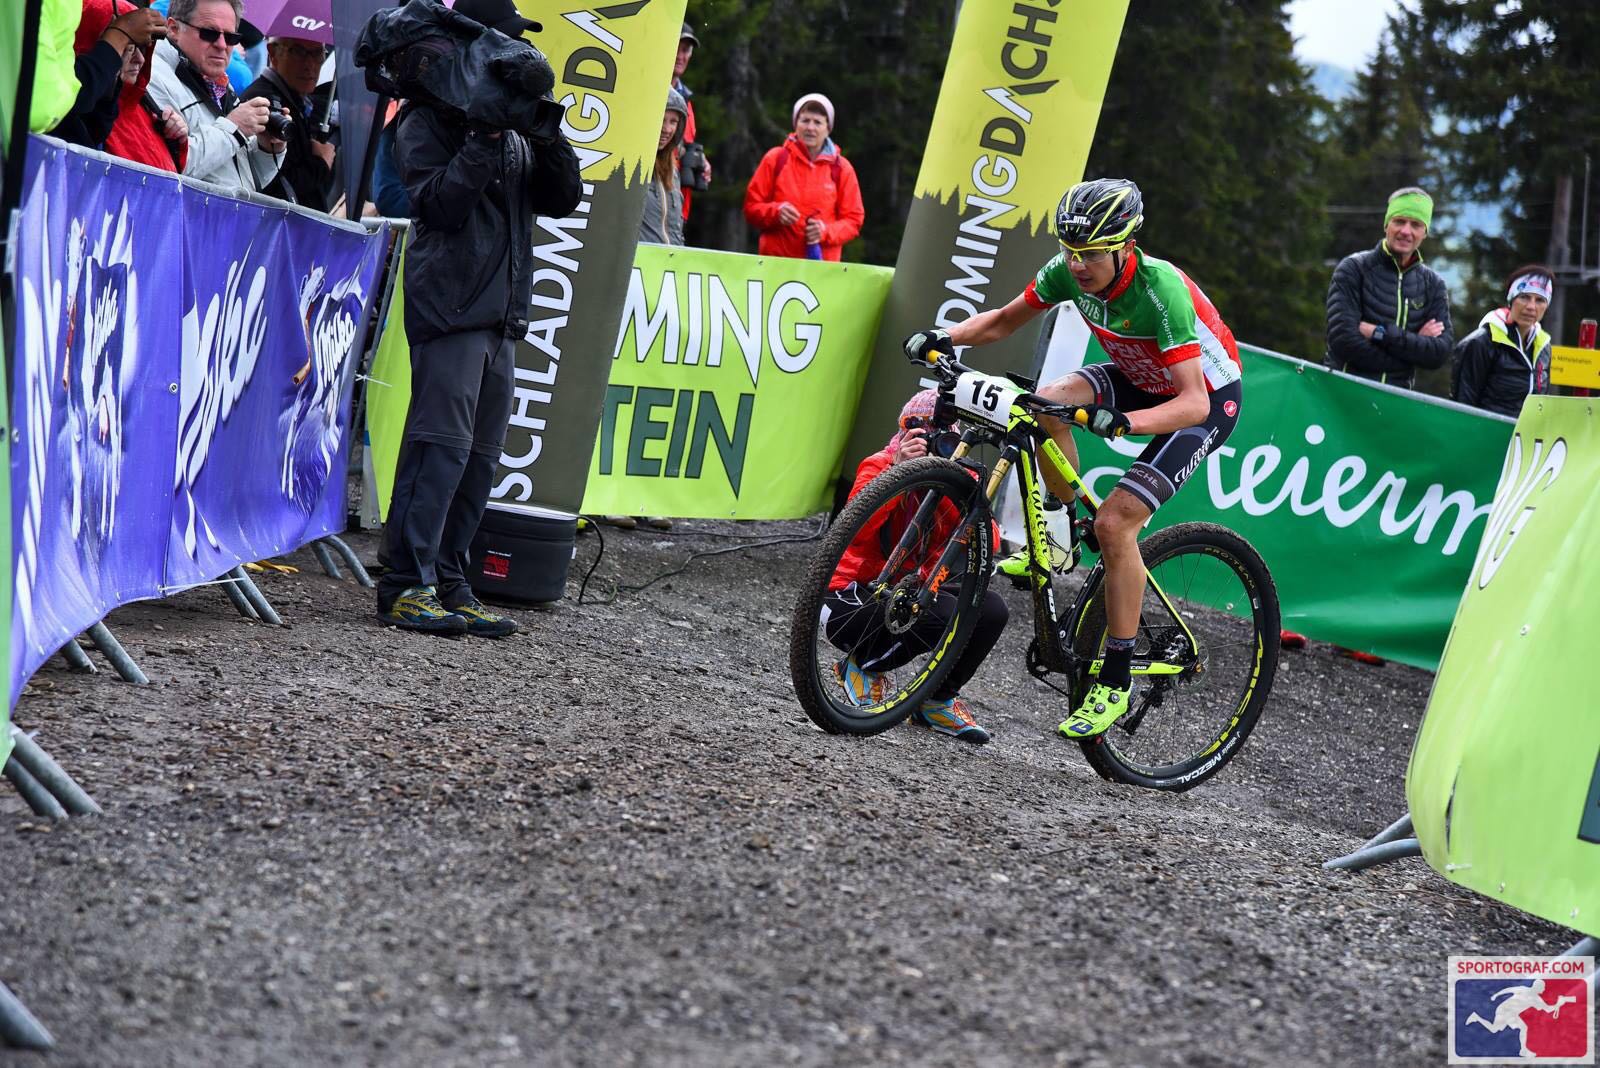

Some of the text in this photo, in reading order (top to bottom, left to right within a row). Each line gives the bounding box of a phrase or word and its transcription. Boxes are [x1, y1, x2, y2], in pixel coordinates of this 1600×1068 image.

[489, 0, 650, 502] SCHLADMGDA
[318, 305, 357, 388] Milka
[613, 266, 823, 389] MING
[971, 380, 1004, 412] 15
[599, 384, 756, 500] TEIN
[978, 521, 988, 576] MEZCAL
[1178, 753, 1223, 784] MEZCAL
